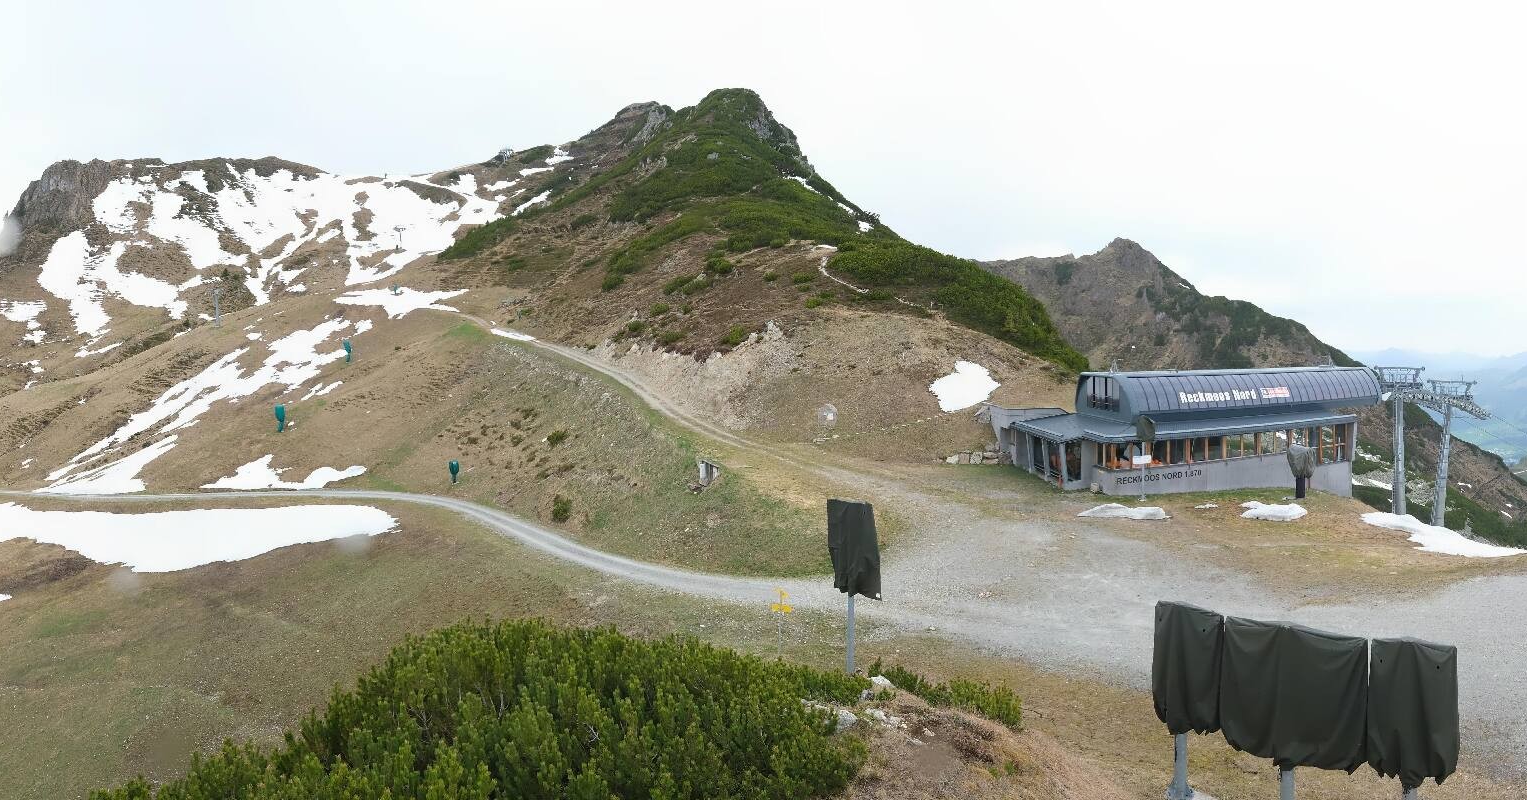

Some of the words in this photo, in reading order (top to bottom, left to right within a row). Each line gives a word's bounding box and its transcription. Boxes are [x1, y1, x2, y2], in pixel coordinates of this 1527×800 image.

[1179, 391, 1231, 403] Reckmoos
[1232, 389, 1257, 401] Nord
[1162, 471, 1183, 480] NORD
